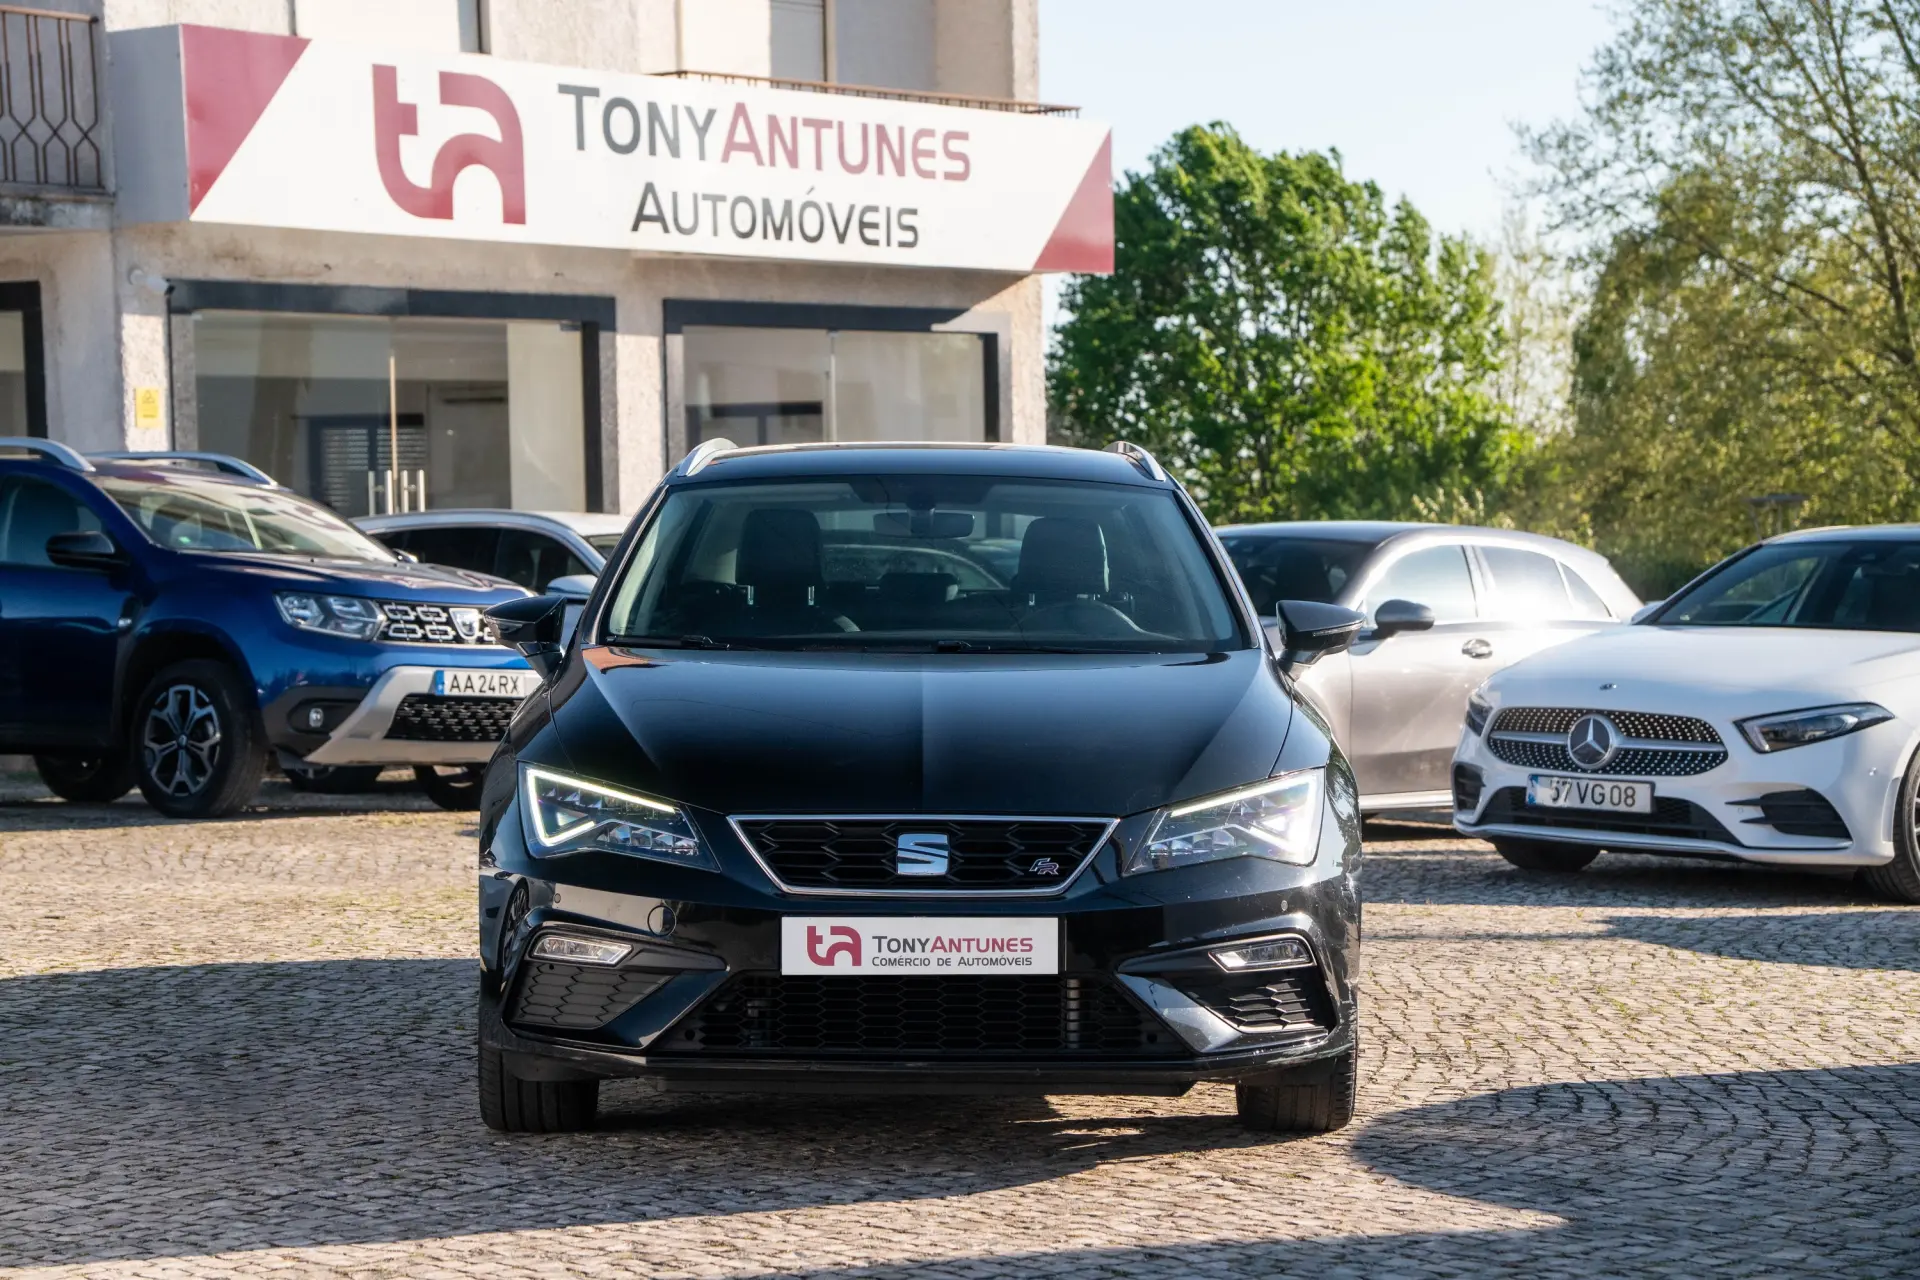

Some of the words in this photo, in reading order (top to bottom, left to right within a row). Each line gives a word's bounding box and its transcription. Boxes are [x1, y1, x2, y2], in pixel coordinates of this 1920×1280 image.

[631, 182, 918, 248] AUTOMÓVEIS
[1029, 857, 1059, 875] FR
[872, 955, 931, 966] COMÉRCIO
[937, 958, 951, 966] DE
[958, 955, 1032, 966] AUTOMÓVEIS
